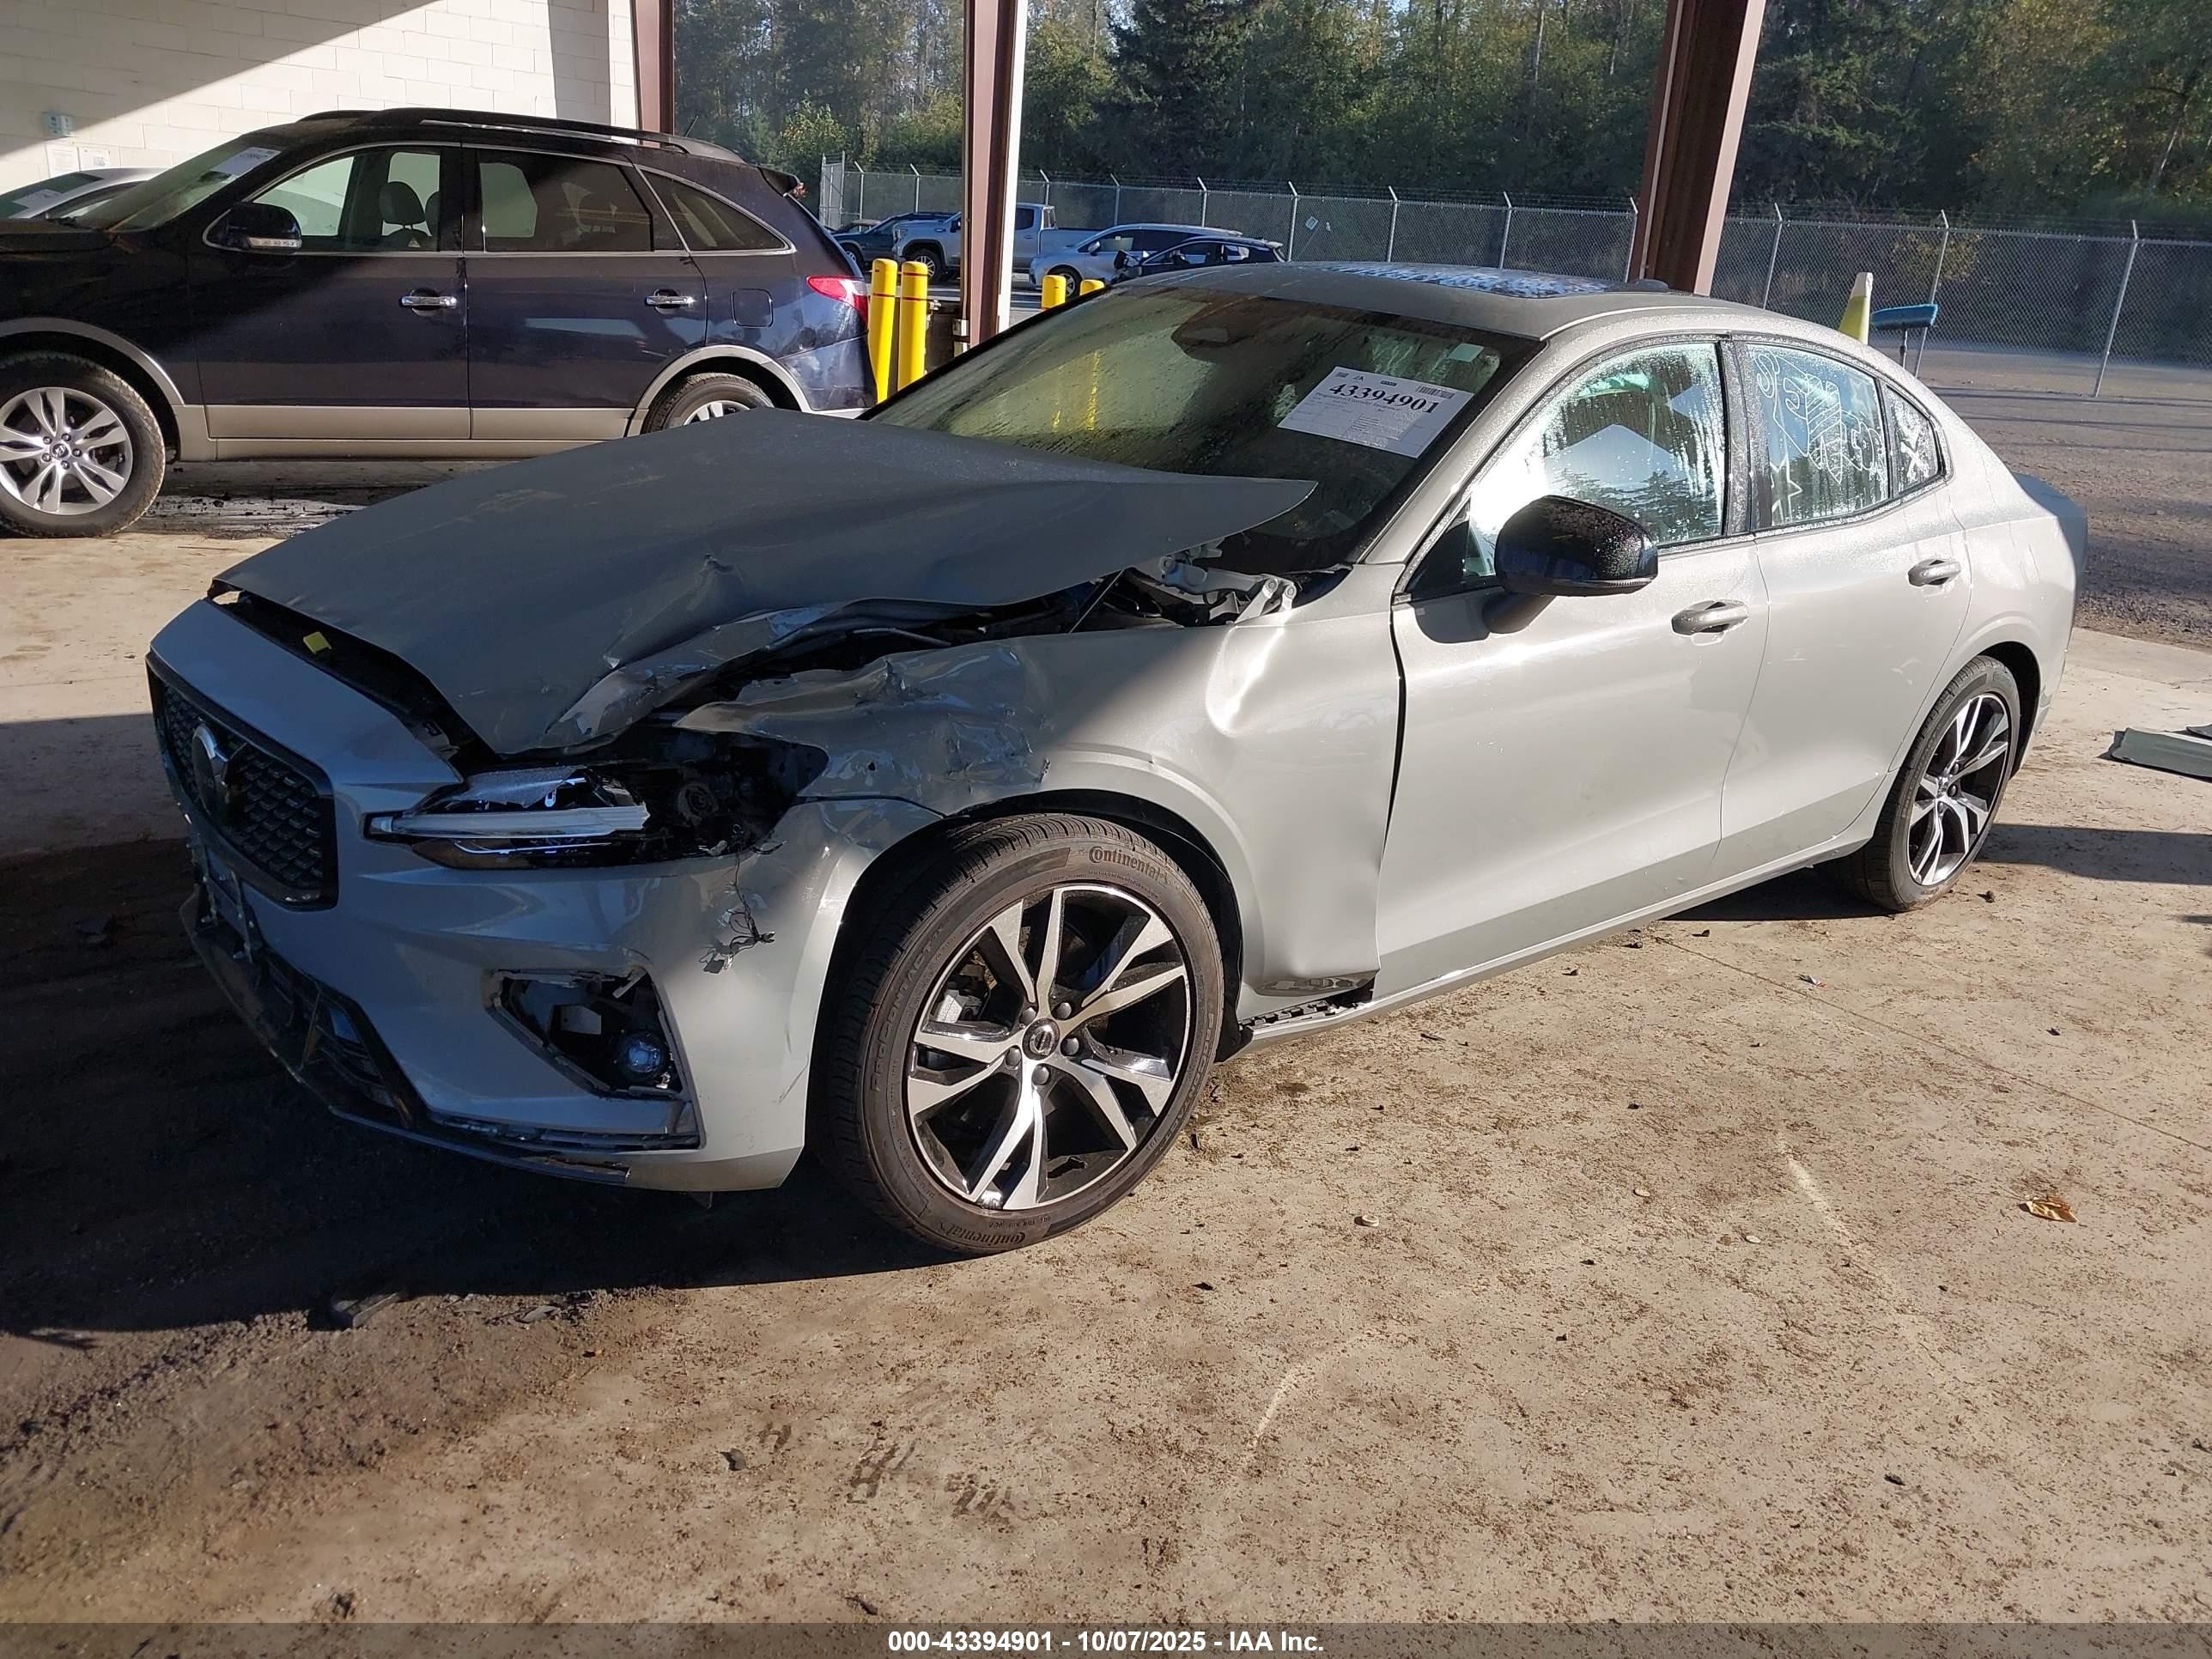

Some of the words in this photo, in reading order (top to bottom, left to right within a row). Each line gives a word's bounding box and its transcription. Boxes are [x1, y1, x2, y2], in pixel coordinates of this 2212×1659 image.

[1329, 384, 1440, 414] 43394901
[1089, 846, 1161, 882] Continental
[946, 1224, 1026, 1247] Continental
